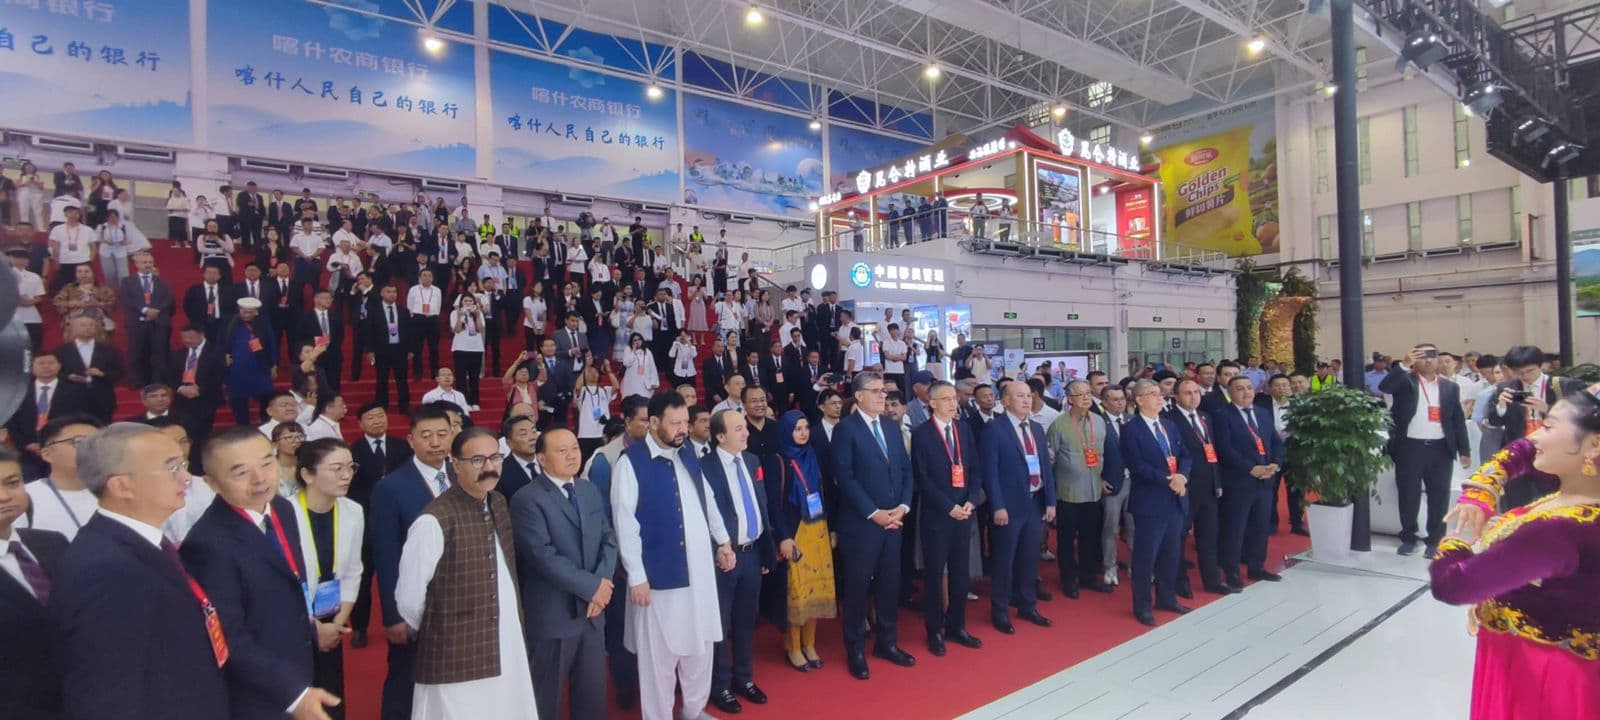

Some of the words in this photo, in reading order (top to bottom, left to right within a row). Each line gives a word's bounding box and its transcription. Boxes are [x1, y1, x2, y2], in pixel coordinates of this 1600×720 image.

[0, 27, 160, 71] 自己的银行
[272, 34, 430, 80] 喀什农商银行
[234, 64, 459, 119] 喀什人民自己的银行
[531, 86, 641, 119] 喀什农商银行
[507, 112, 665, 150] 喀什人民自己的银行
[1178, 167, 1227, 197] Golden
[1188, 182, 1220, 203] Chips
